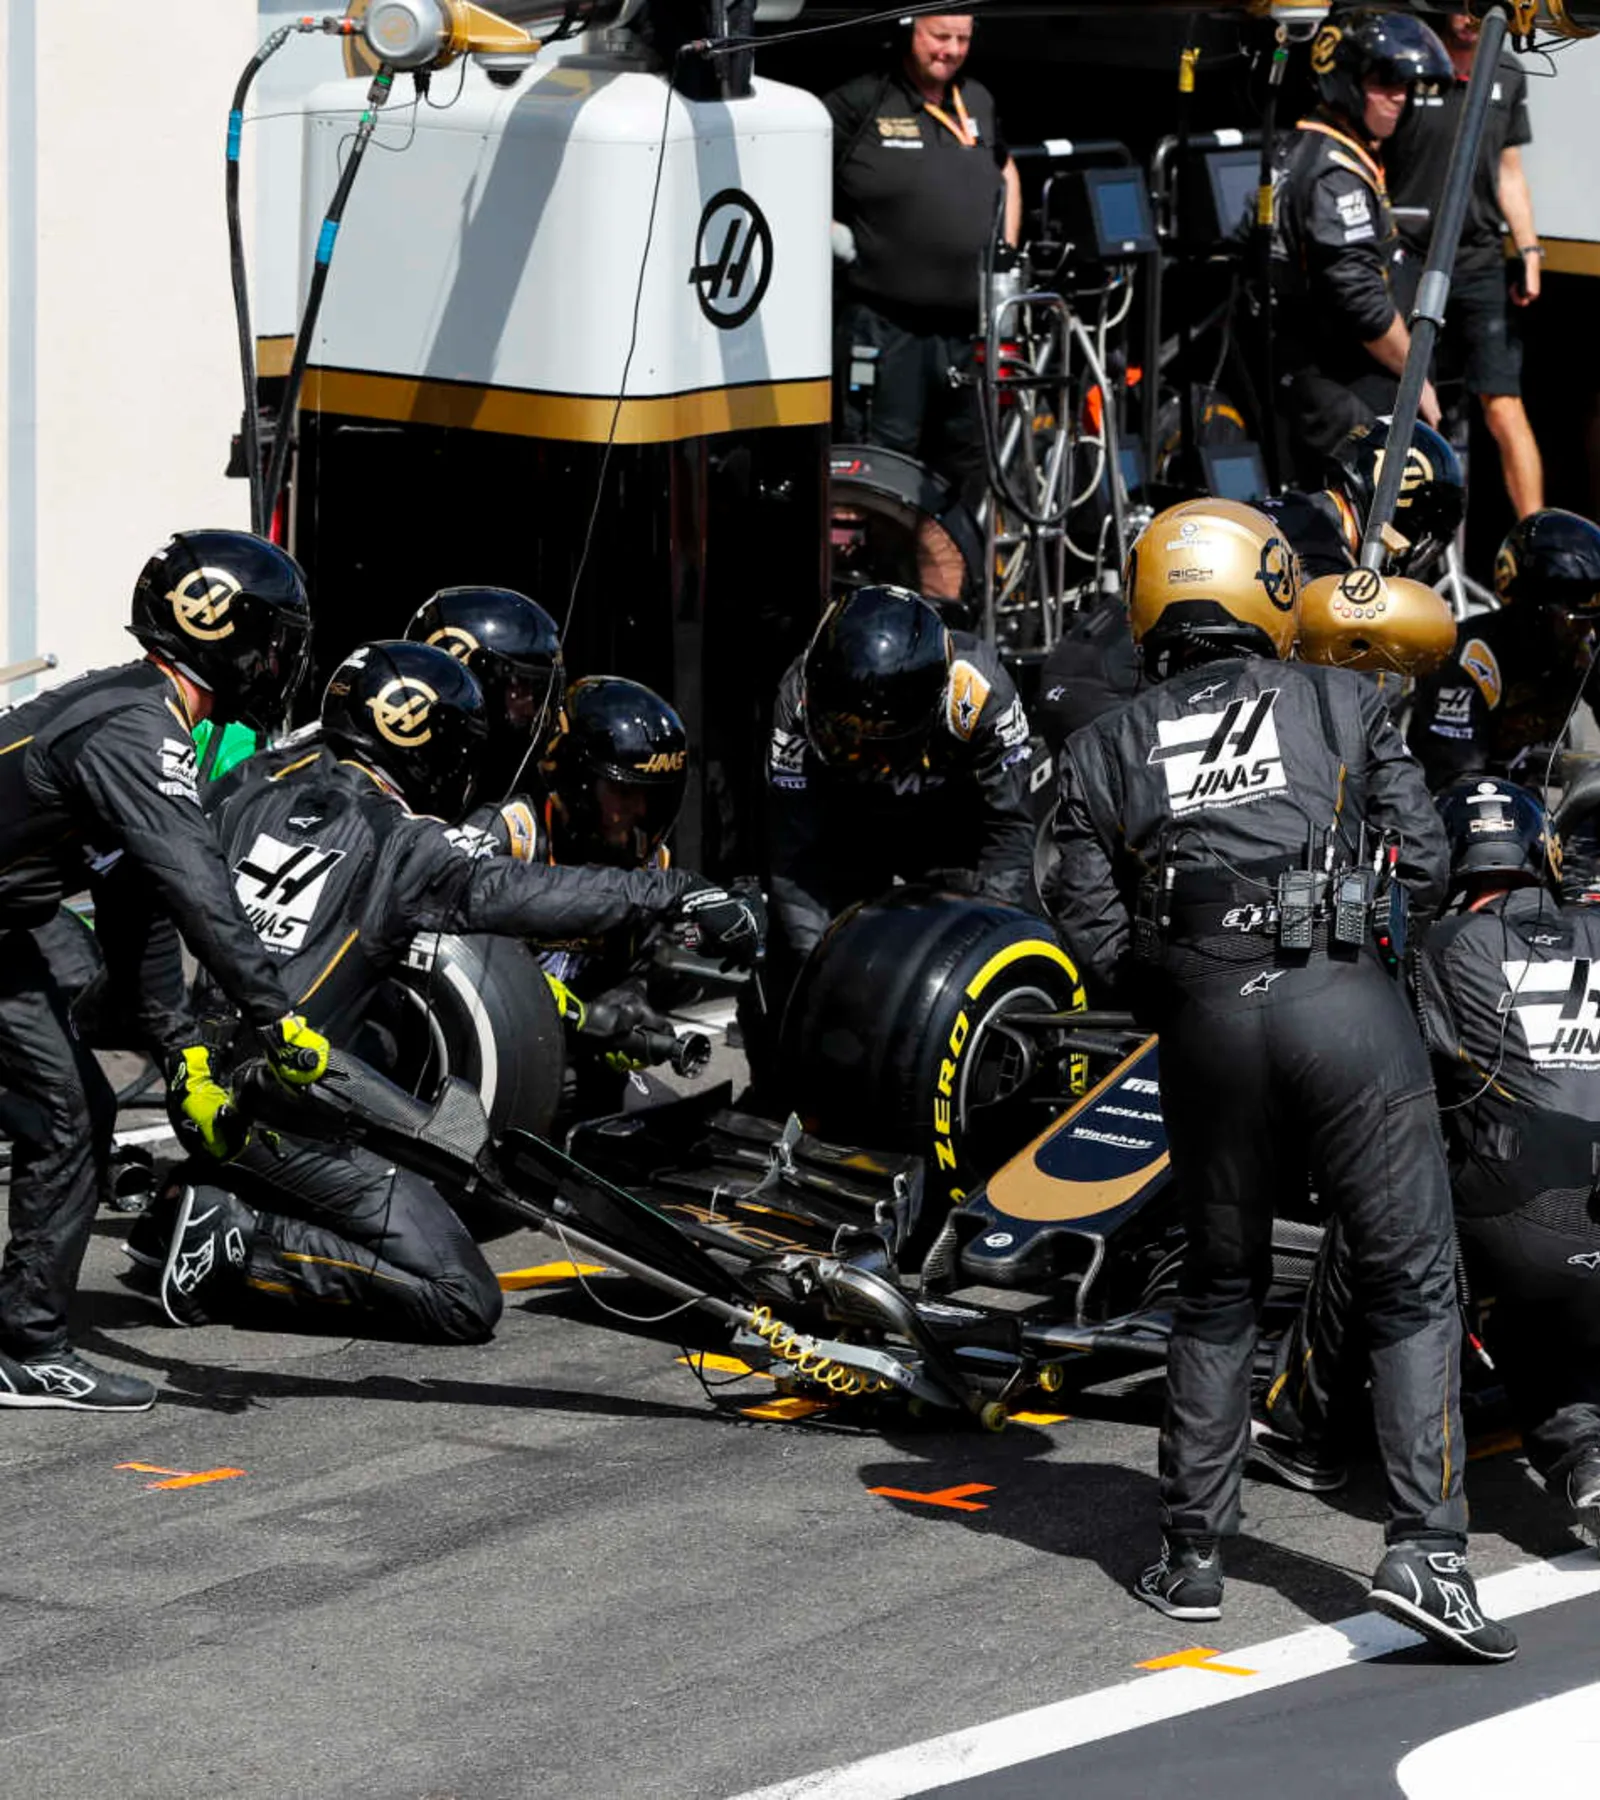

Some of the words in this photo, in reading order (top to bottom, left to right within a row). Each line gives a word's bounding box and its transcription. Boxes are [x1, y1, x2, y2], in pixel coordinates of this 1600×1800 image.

[1168, 567, 1214, 580] RICH
[633, 750, 687, 773] HAAS
[1170, 756, 1281, 800] HAAS
[933, 1010, 970, 1171] ZERO
